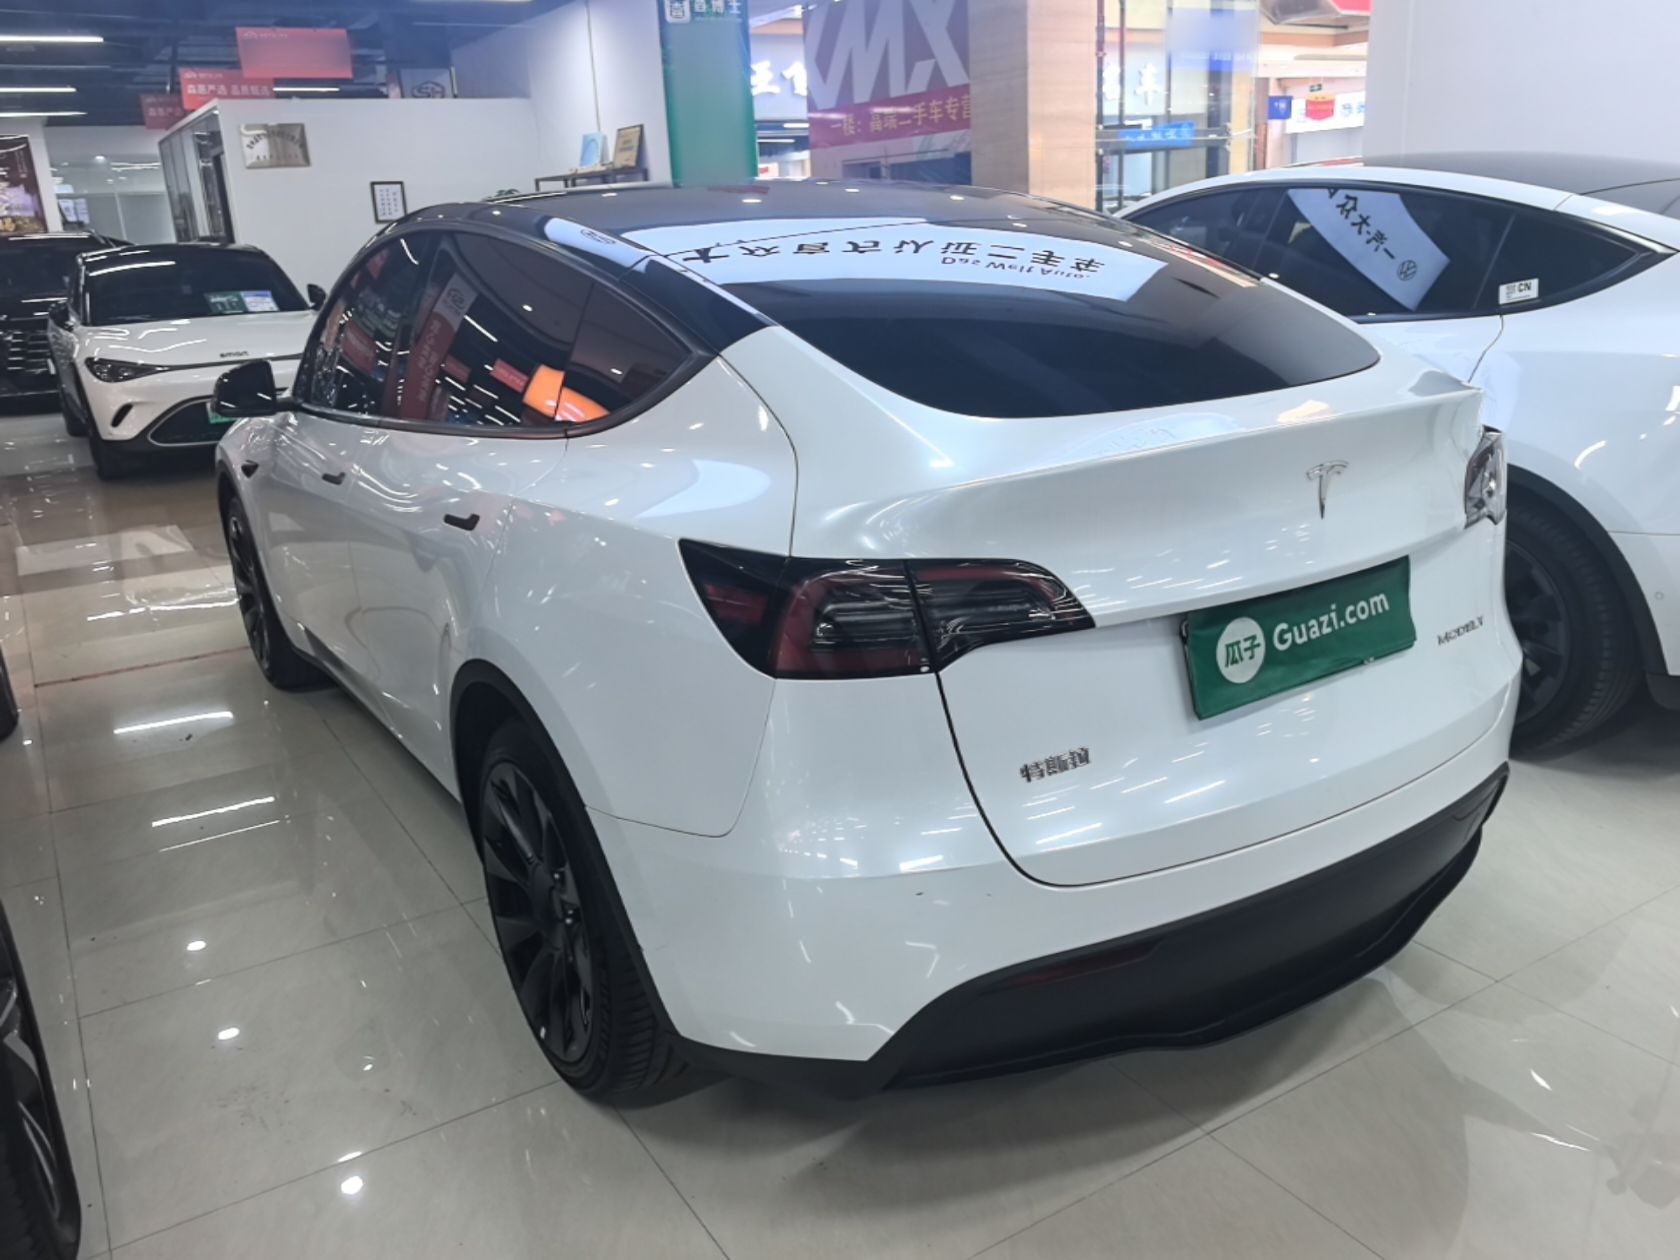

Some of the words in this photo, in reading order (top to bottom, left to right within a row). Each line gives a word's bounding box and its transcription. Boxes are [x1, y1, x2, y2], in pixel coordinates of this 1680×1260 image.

[1517, 281, 1532, 294] CN
[1272, 592, 1390, 652] Guazi.com
[1224, 633, 1261, 668] 瓜子
